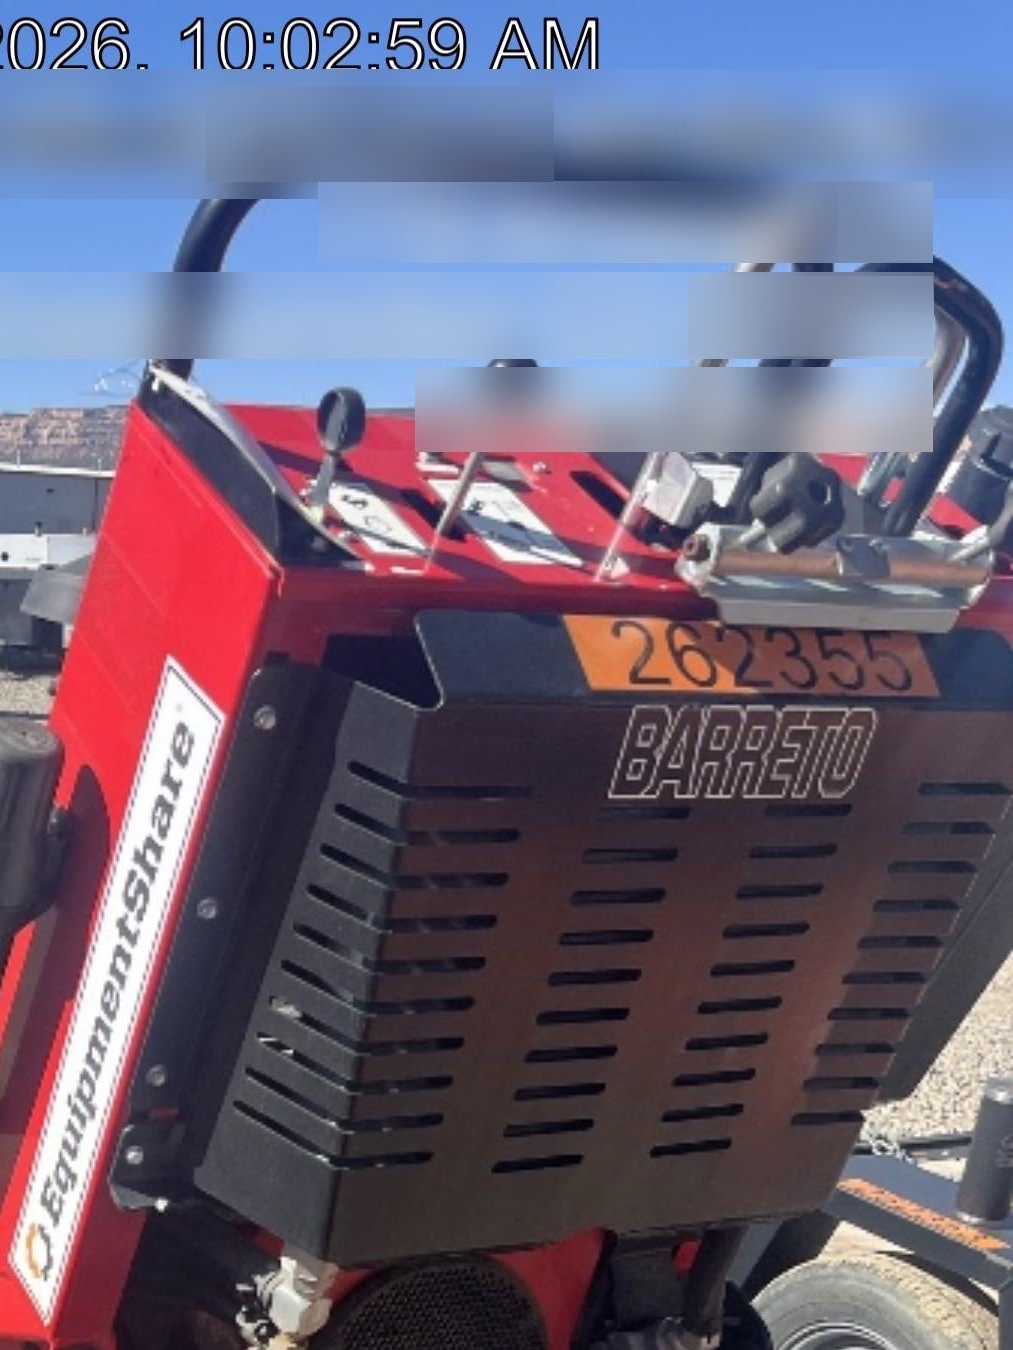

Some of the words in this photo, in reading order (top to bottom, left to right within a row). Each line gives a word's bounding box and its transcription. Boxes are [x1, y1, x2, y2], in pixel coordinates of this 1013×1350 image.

[610, 619, 912, 691] 262355
[608, 705, 877, 798] BARRETO
[41, 721, 195, 1226] EquipmentShare
